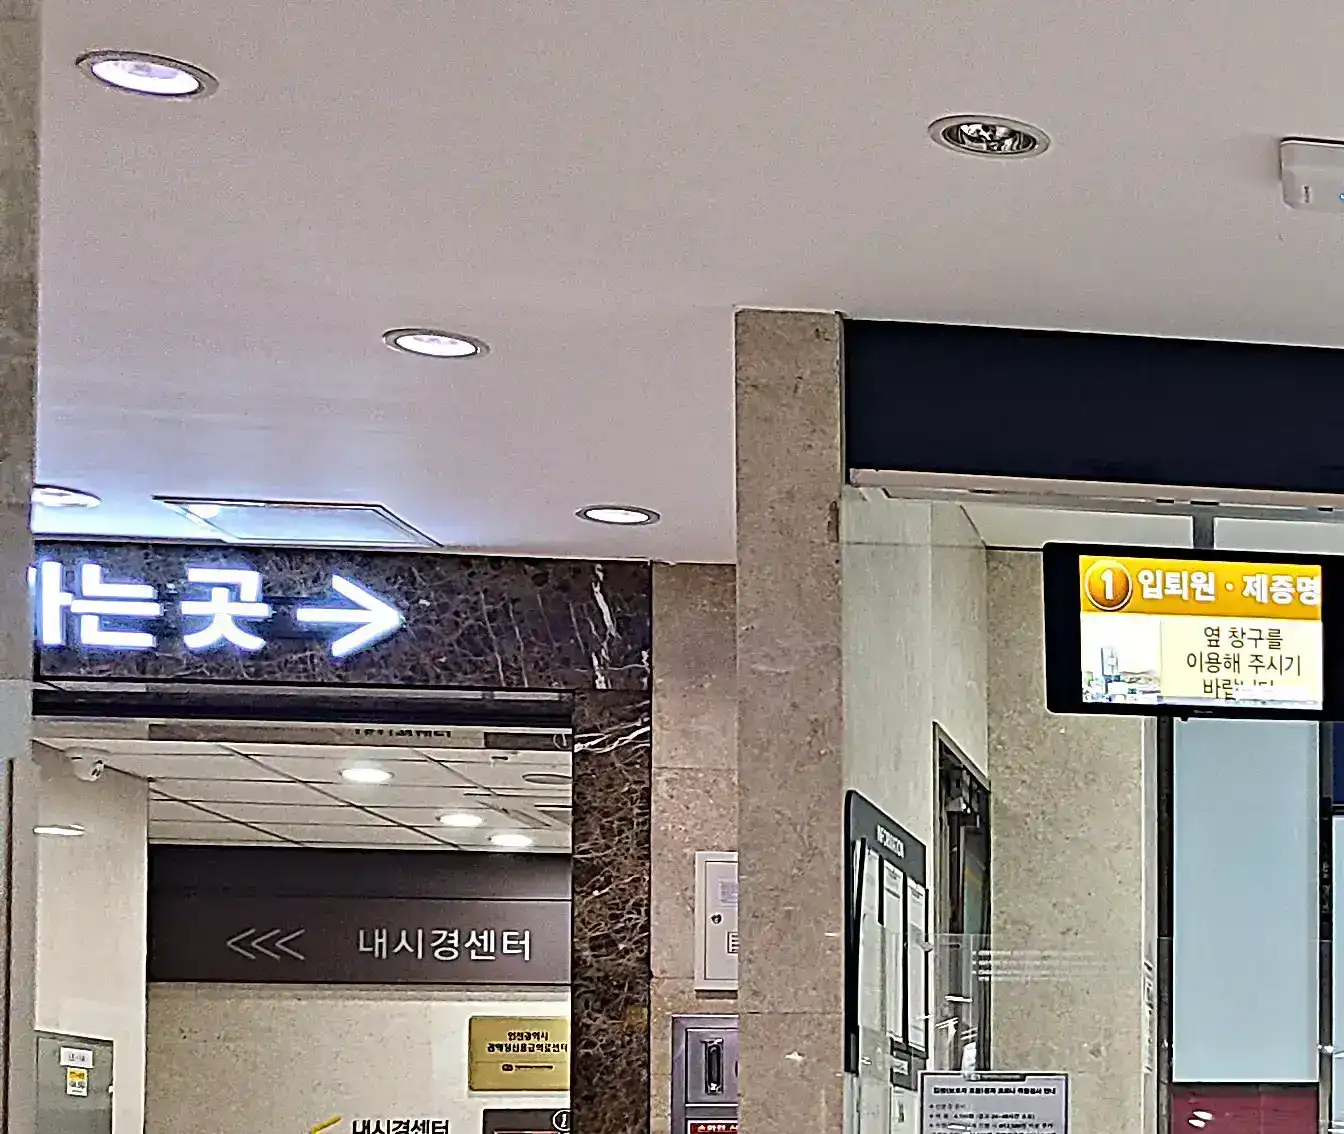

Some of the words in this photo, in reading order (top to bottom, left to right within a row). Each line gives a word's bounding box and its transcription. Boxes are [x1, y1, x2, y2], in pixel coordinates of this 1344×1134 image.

[1100, 569, 1115, 600] 1
[1137, 569, 1216, 602] 입퇴원
[1241, 573, 1321, 606] 제증명
[181, 566, 272, 652] 곳
[1203, 626, 1221, 649] 옆
[1227, 626, 1283, 650] 창구를
[1186, 652, 1241, 675] 이용해
[1248, 654, 1301, 677] 주시기
[358, 926, 533, 963] 내시경센터
